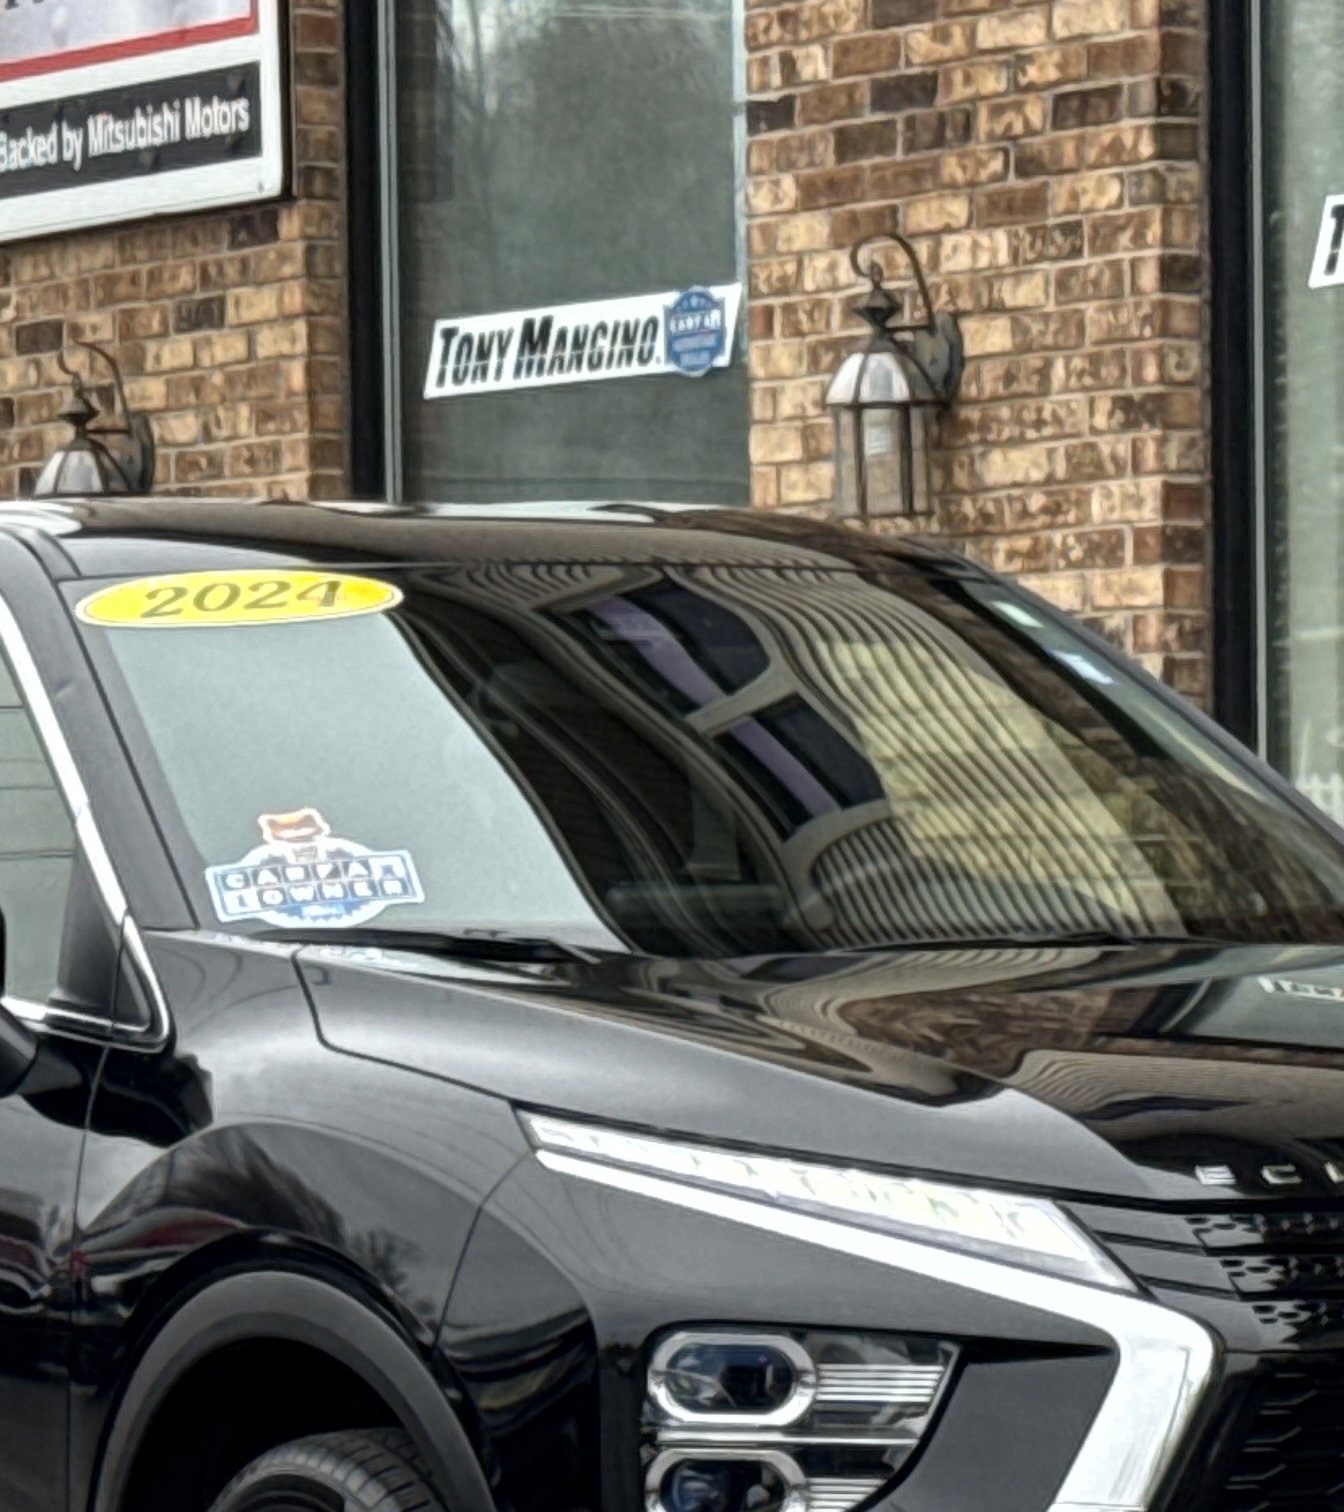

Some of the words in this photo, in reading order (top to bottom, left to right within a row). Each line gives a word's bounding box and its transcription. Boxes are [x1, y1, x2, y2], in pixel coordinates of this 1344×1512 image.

[62, 120, 83, 171] by
[88, 98, 181, 157] Mitsubishi
[185, 95, 250, 140] Motors
[436, 326, 514, 387] TONY
[140, 580, 342, 618] 2024
